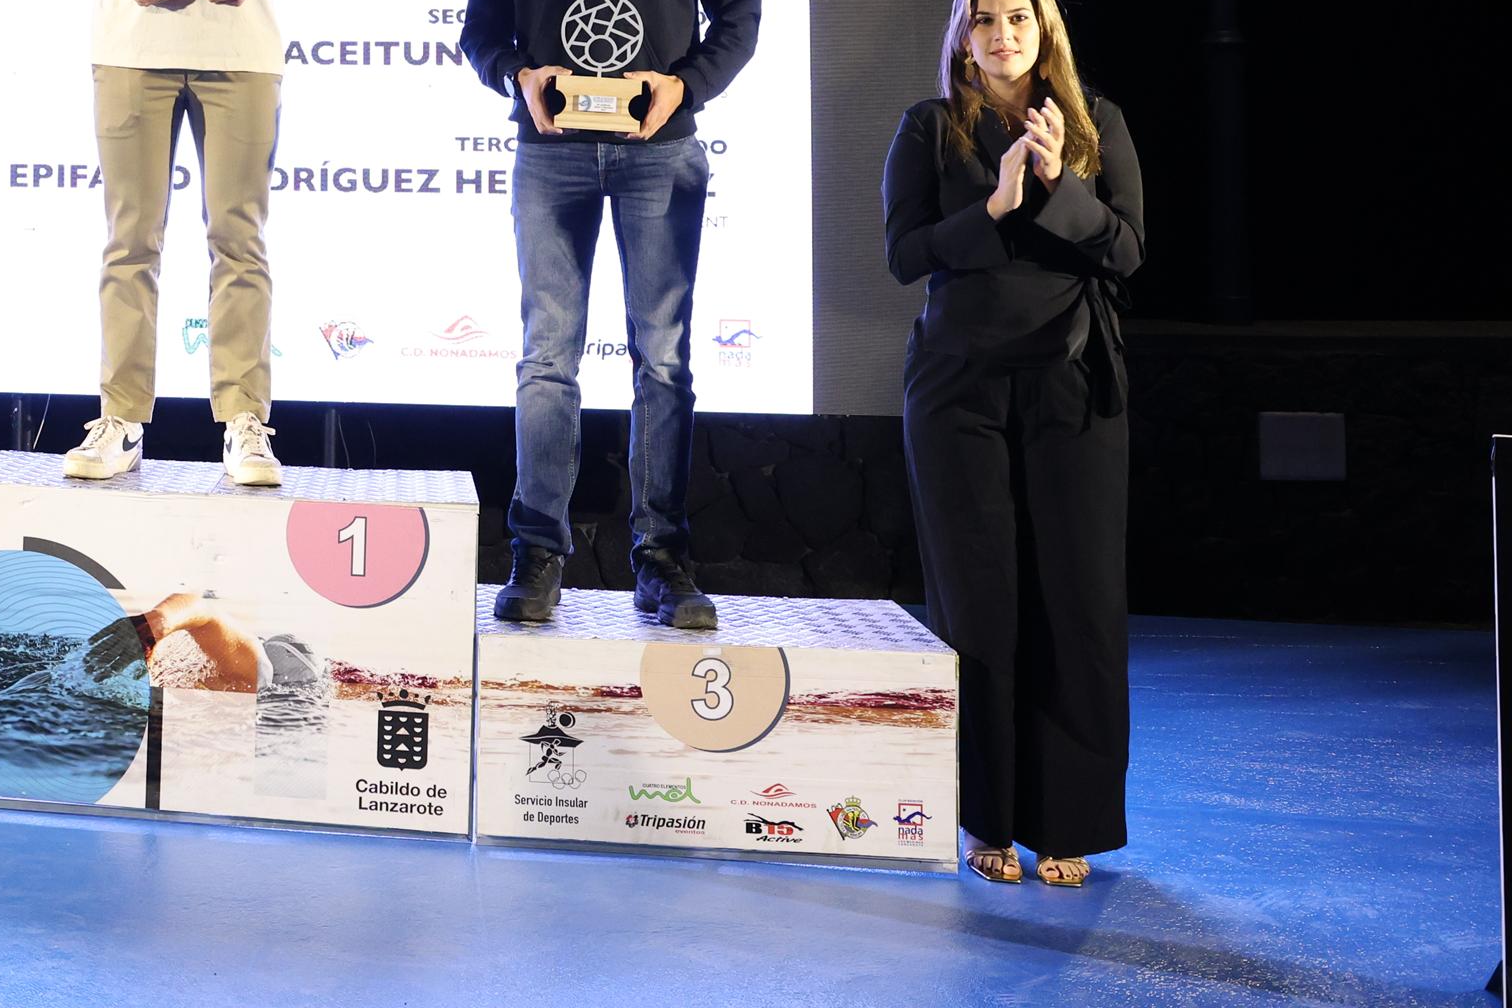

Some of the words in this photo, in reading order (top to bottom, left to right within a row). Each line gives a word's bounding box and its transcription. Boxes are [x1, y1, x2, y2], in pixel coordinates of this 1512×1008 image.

[284, 40, 463, 66] ACEITUN
[455, 137, 516, 153] TERC
[270, 160, 441, 193] DRÍGUEZ
[429, 348, 518, 360] NONADAMOS
[337, 516, 367, 577] 1
[689, 657, 734, 721] 3
[355, 778, 421, 797] Cabildo
[426, 784, 448, 799] de
[358, 796, 444, 816] Lanzarote
[514, 793, 553, 807] Servicio
[555, 795, 588, 808] Insular
[752, 800, 817, 809] NONADAMOS
[523, 811, 535, 822] de
[537, 812, 580, 825] Deportes
[640, 814, 706, 830] Tripasión
[756, 835, 803, 844] Active
